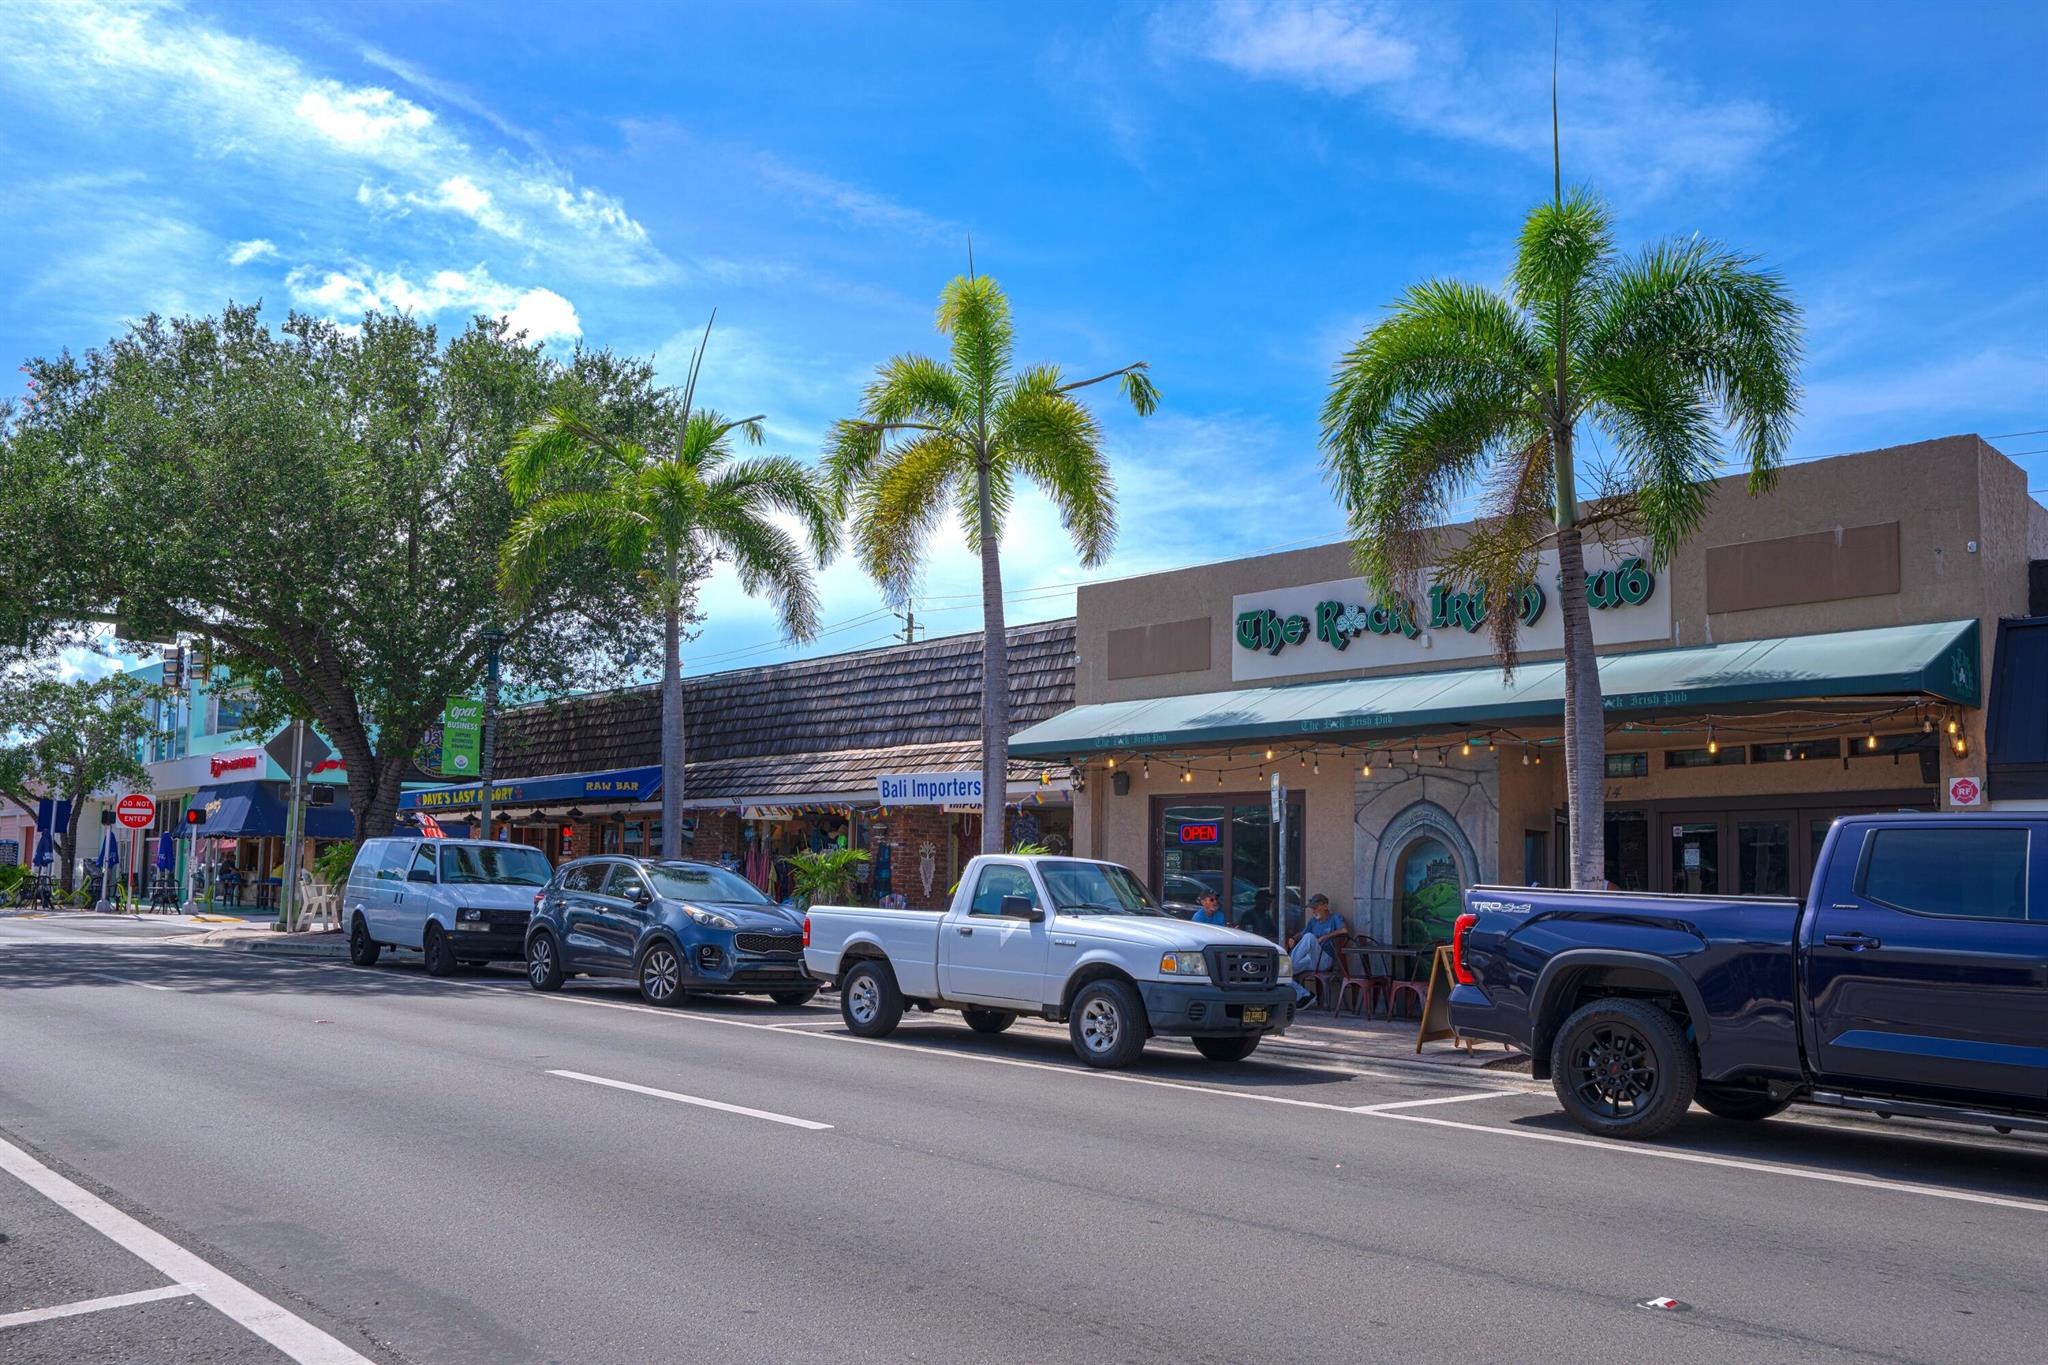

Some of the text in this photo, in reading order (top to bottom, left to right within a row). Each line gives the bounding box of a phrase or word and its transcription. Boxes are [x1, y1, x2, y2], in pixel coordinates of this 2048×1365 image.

[1236, 607, 1311, 656] The
[1556, 557, 1656, 611] ub
[1631, 695, 1660, 706] Irish
[1663, 692, 1688, 705] Pub
[451, 706, 477, 719] Open
[447, 721, 478, 730] BUSINESS
[586, 781, 639, 791] RAW BAR
[882, 778, 981, 801] Bali Importers
[1959, 788, 1971, 796] RF
[422, 792, 451, 805] DAVE'S
[453, 789, 475, 803] LAST
[136, 800, 150, 808] NOT
[124, 815, 147, 823] ENTER
[1182, 825, 1217, 841] OPEN
[1471, 901, 1502, 912] TRD
